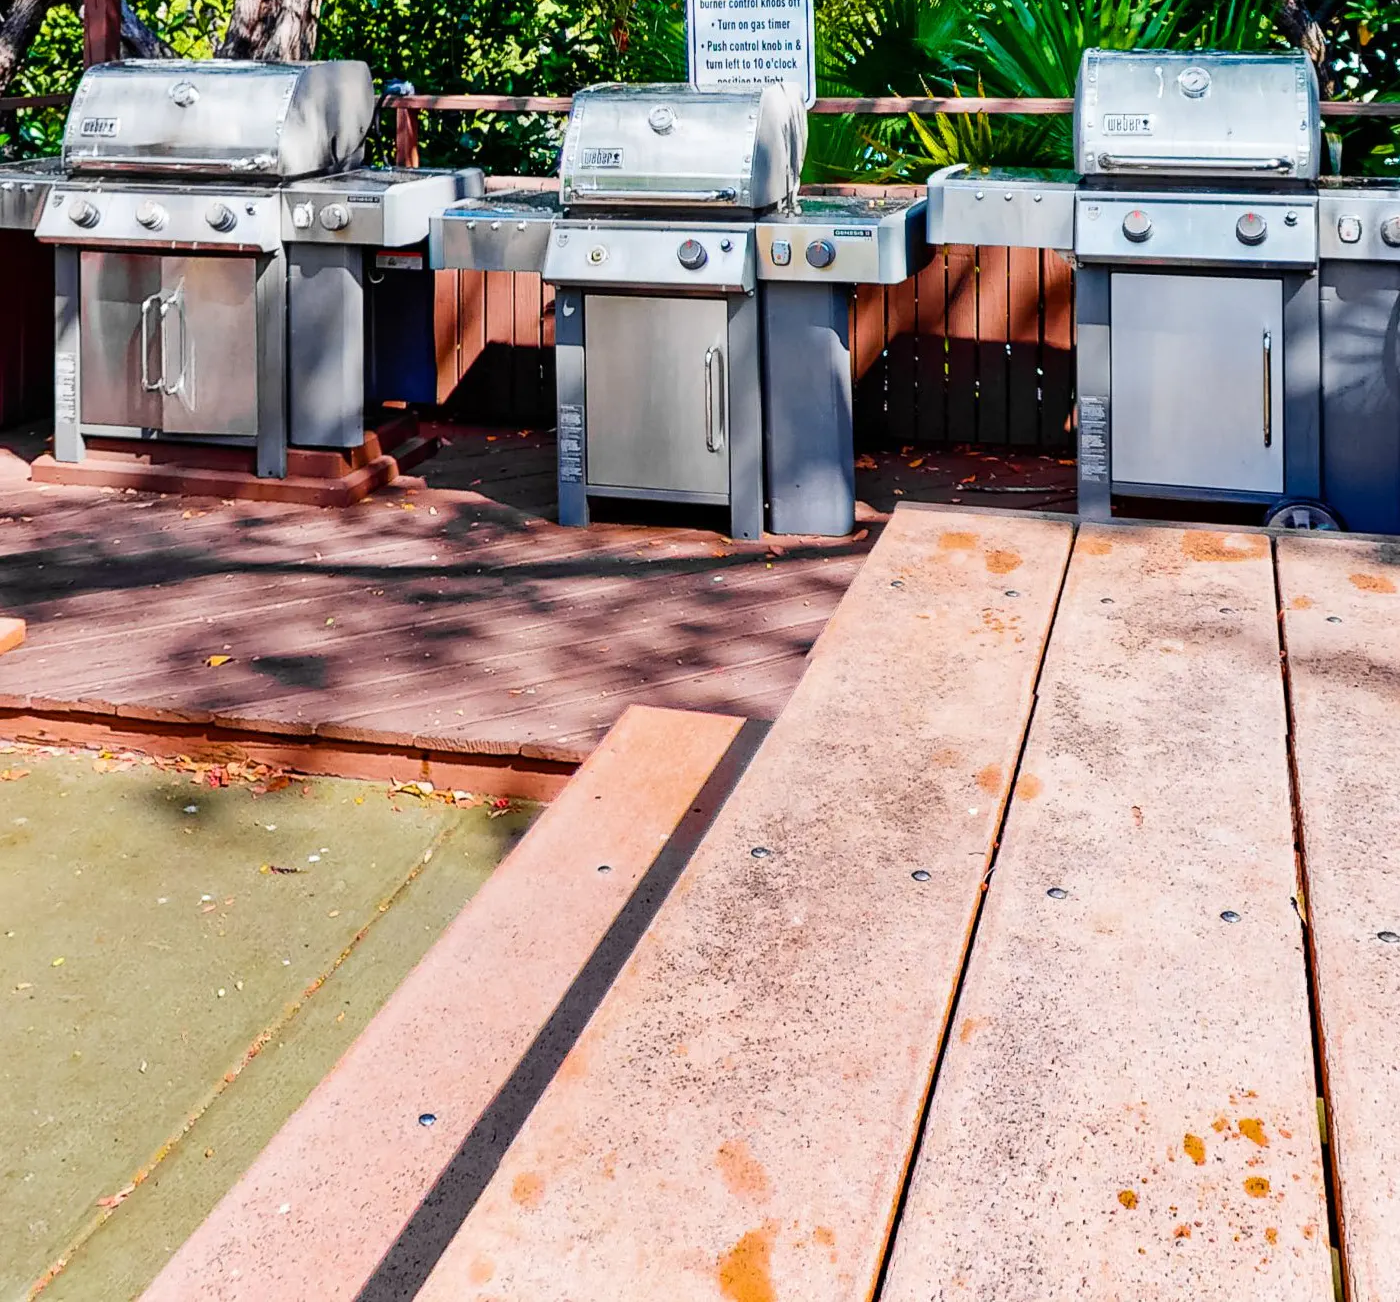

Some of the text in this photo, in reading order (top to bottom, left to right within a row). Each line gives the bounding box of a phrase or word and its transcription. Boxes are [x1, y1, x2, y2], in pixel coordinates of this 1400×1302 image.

[717, 19, 791, 32] Turn on gas timer
[707, 39, 802, 52] Push control knob in &
[706, 58, 798, 69] turn left to 10 o'clock
